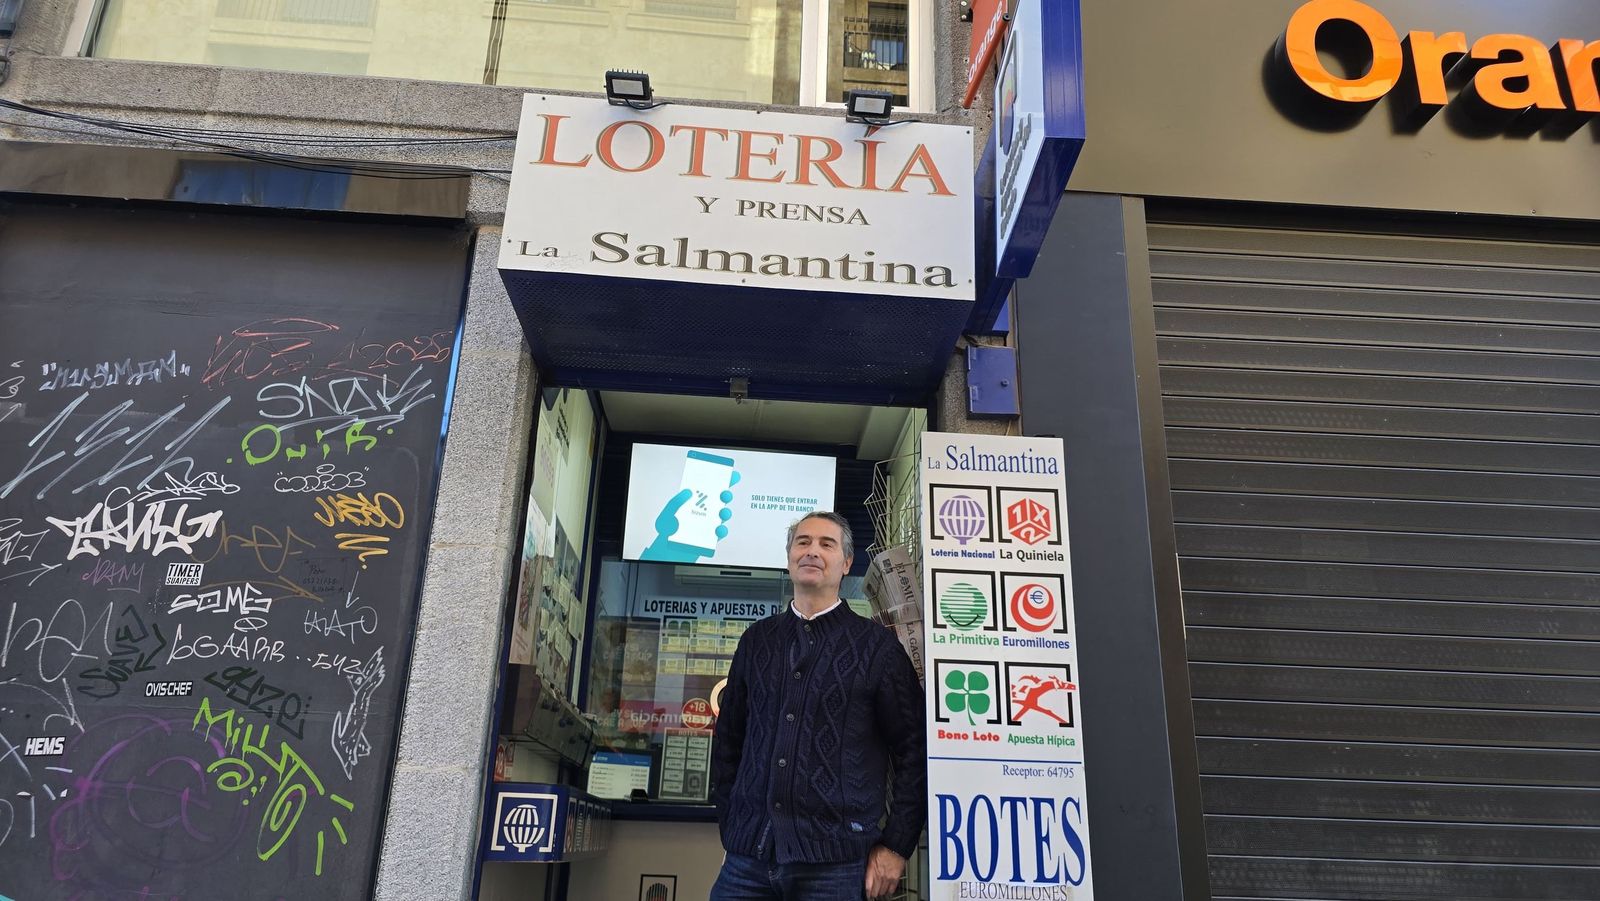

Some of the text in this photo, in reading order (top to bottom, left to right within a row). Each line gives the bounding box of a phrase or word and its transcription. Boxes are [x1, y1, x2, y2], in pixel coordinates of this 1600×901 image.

[530, 113, 958, 197] LOTERÍA
[694, 196, 870, 226] Y PRENSA
[516, 231, 959, 288] La Salmantina
[928, 445, 1059, 475] La Salmantina
[751, 494, 766, 502] SOLO
[766, 496, 784, 504] TIENES
[785, 497, 796, 505] QUE
[767, 503, 778, 511] APP
[961, 550, 996, 559] Nacional
[1000, 549, 1064, 562] La Quiniela
[168, 564, 201, 578] TIMER
[901, 585, 915, 603] MU
[644, 600, 698, 613] LOTERIAS
[700, 602, 708, 614] Y
[710, 602, 766, 616] APUESTAS
[933, 633, 1000, 646] La Primitiva
[1002, 636, 1070, 649] Euromillones
[689, 701, 706, 712] +18
[937, 729, 1000, 742] Bono Loto
[1007, 733, 1076, 747] Apuesta Hípica
[25, 738, 65, 755] HEMS
[1002, 764, 1075, 779] Receptor: 64795
[935, 794, 1086, 886] BOTES
[960, 881, 1068, 901] EUROMILLONES
